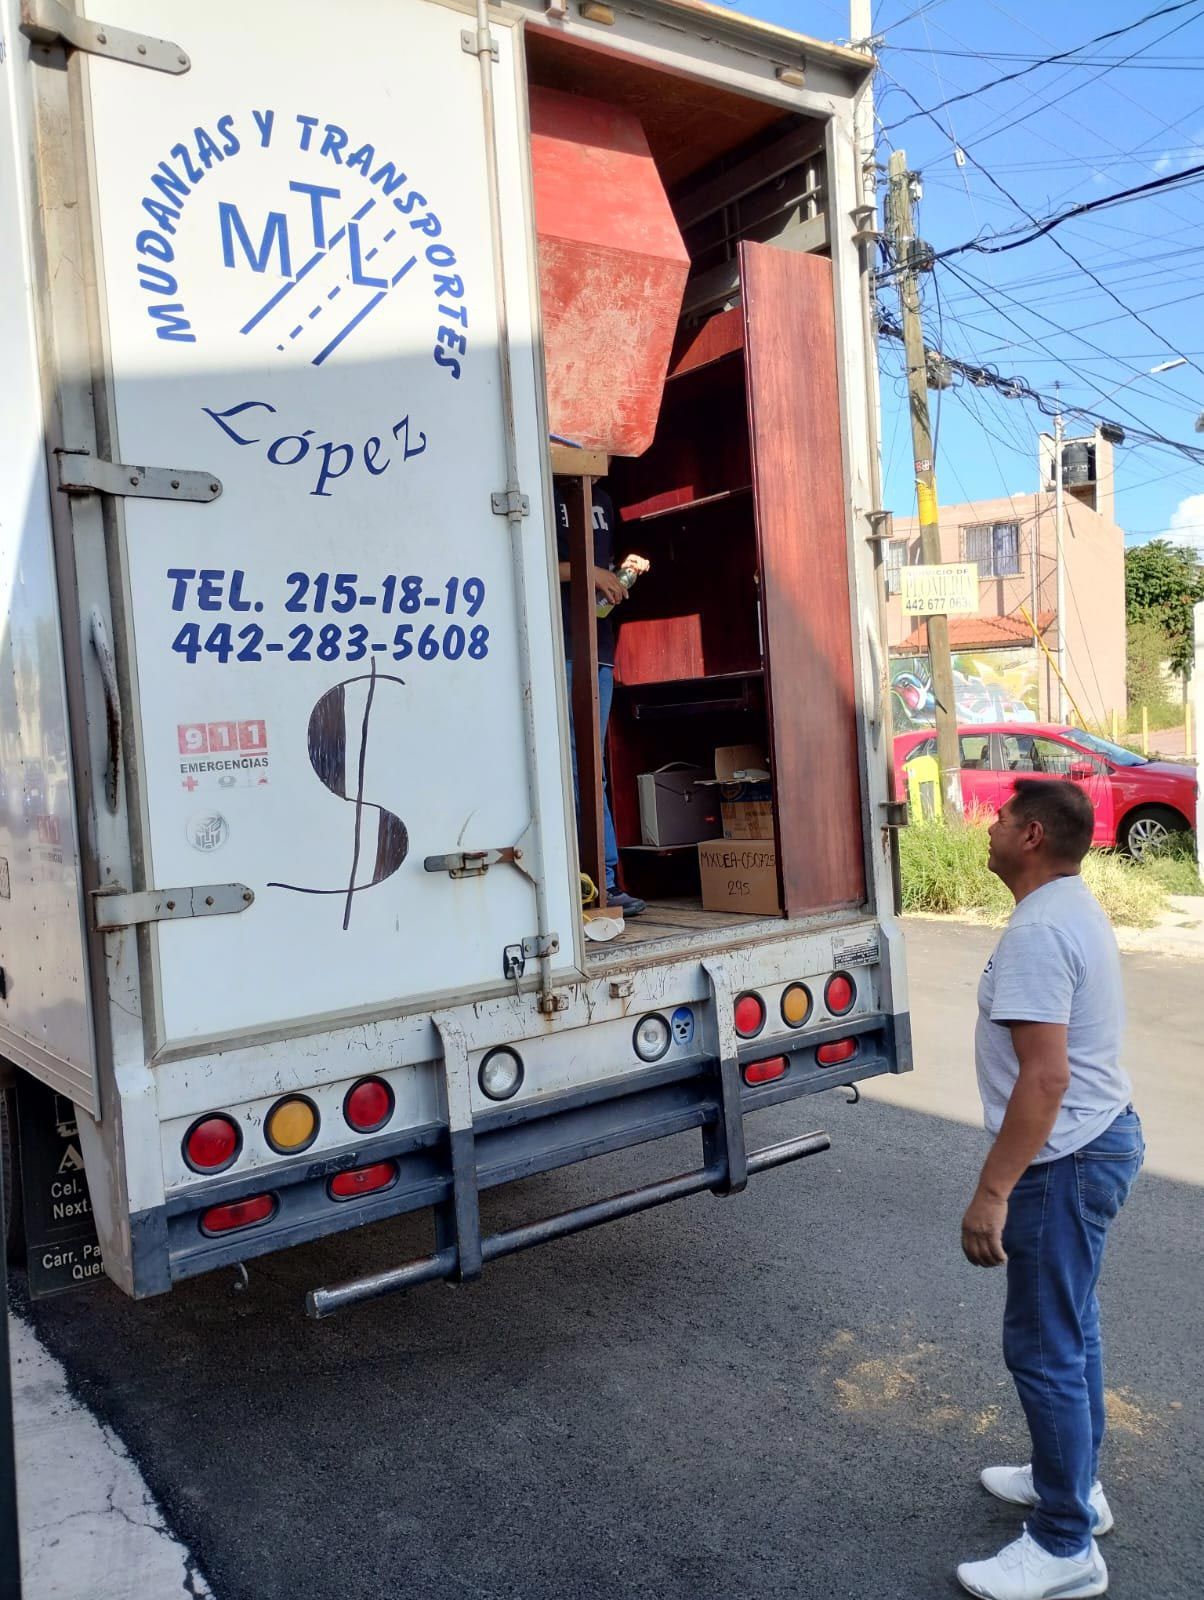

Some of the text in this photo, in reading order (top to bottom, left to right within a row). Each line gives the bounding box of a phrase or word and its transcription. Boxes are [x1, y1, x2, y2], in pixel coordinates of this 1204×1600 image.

[136, 110, 468, 379] MUDANZAS Y TRANSPORTES
[219, 181, 388, 288] MTL
[201, 401, 426, 496] López
[167, 569, 486, 617] TEL. 215-18-19
[906, 599, 924, 611] 442
[927, 598, 946, 611] 677
[171, 623, 490, 664] 442-283-5608
[183, 723, 261, 750] 911
[180, 757, 269, 774] EMERGENCIAS
[51, 1179, 82, 1198] Cel.
[42, 1250, 78, 1270] Carr.
